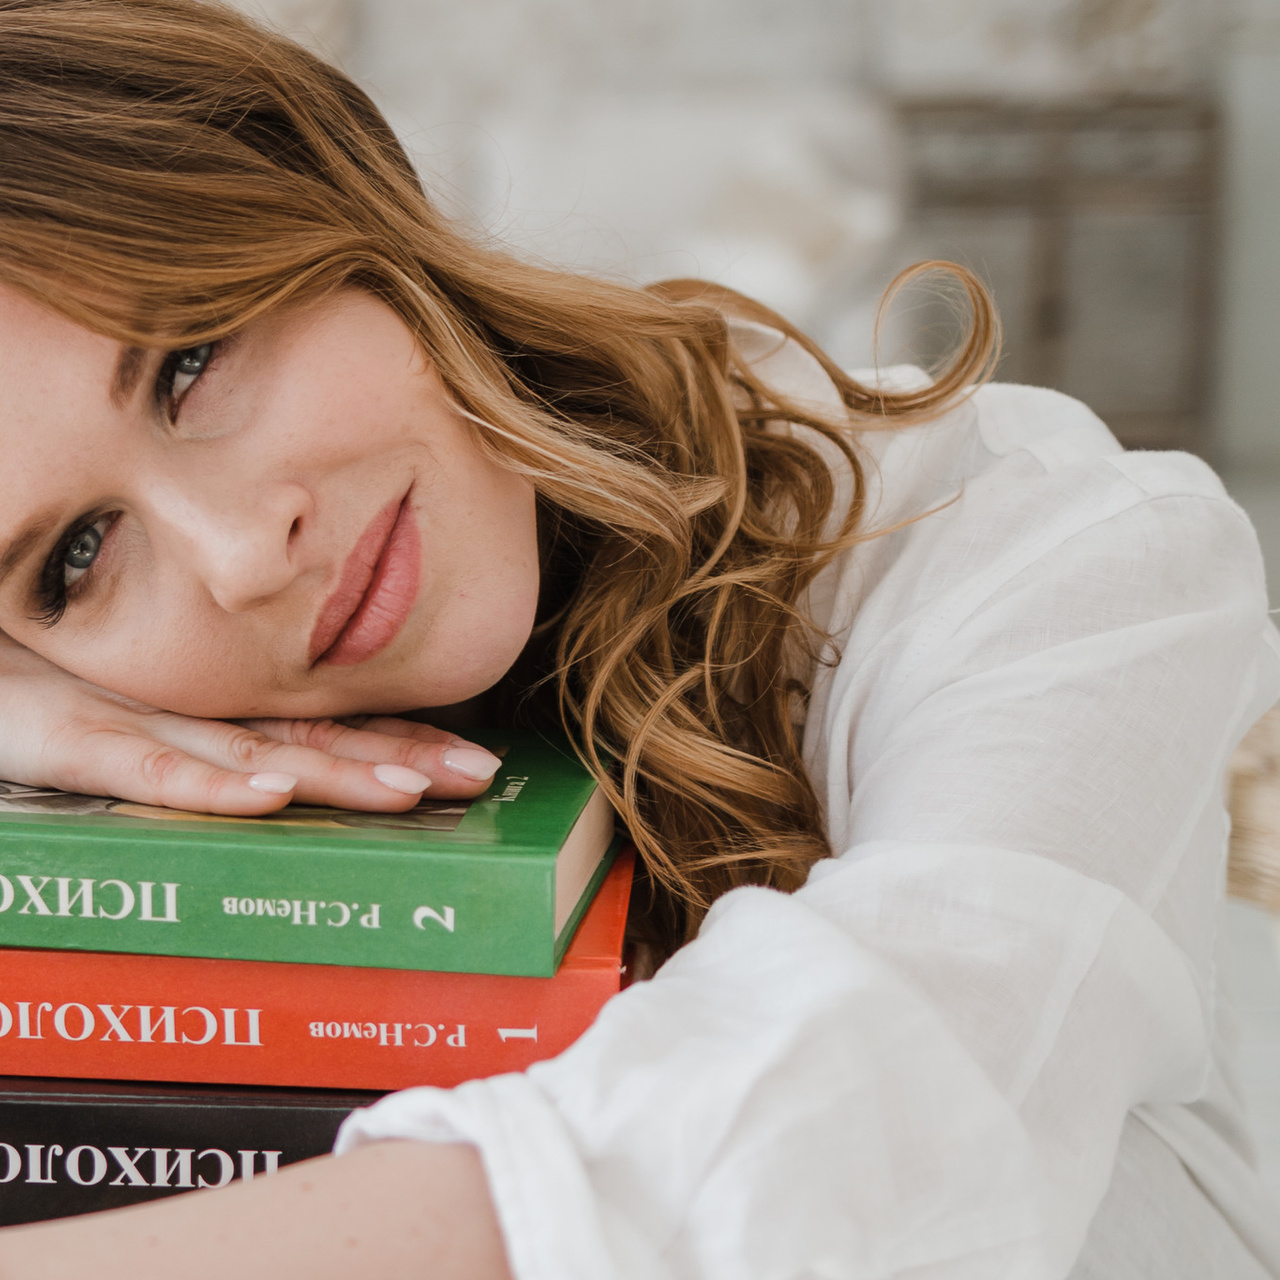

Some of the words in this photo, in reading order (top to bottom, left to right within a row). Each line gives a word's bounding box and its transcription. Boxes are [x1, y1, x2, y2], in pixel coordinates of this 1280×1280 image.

[222, 896, 382, 930] Р.С.Немов
[412, 905, 456, 933] 2
[308, 1021, 467, 1048] Р.С.Немов
[496, 1023, 539, 1044] 1
